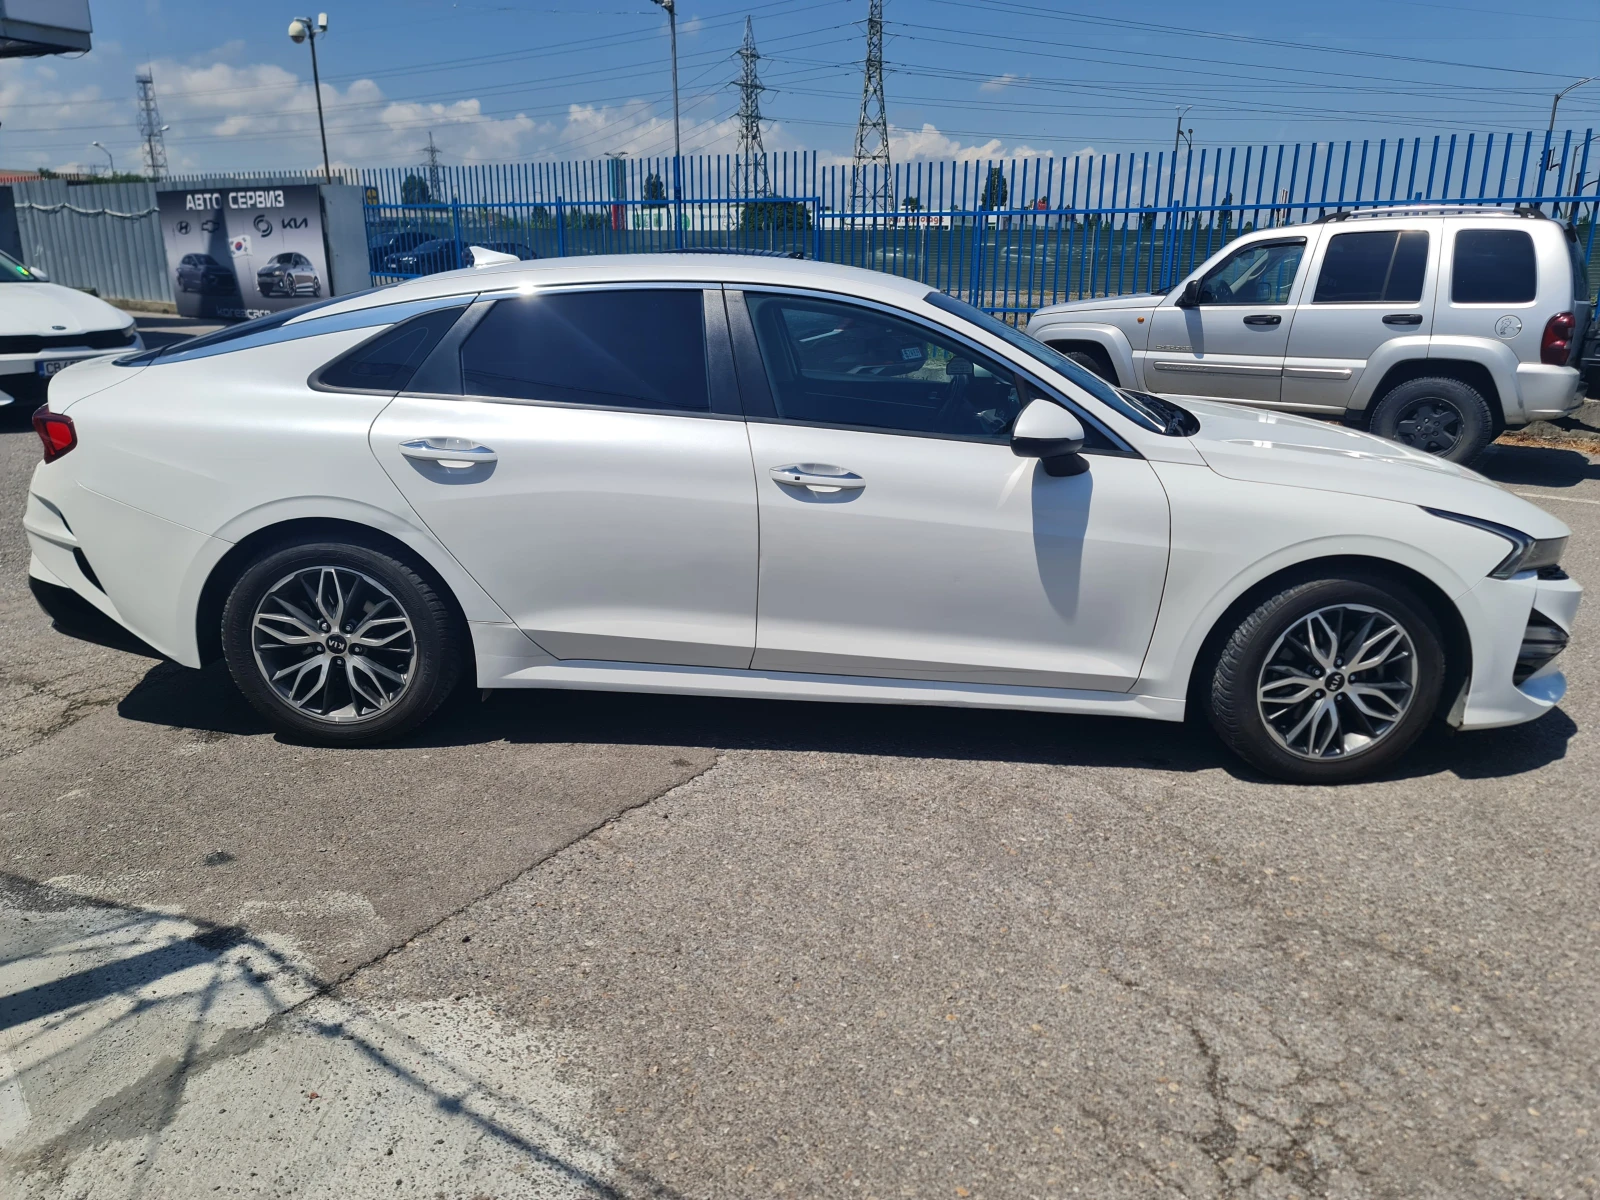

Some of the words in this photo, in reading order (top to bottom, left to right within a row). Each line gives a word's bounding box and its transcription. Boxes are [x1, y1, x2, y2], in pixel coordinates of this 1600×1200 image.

[186, 193, 221, 211] АВТО
[228, 190, 285, 209] СЕРВИЗ
[328, 639, 345, 650] KIA
[1329, 675, 1341, 690] KIA
